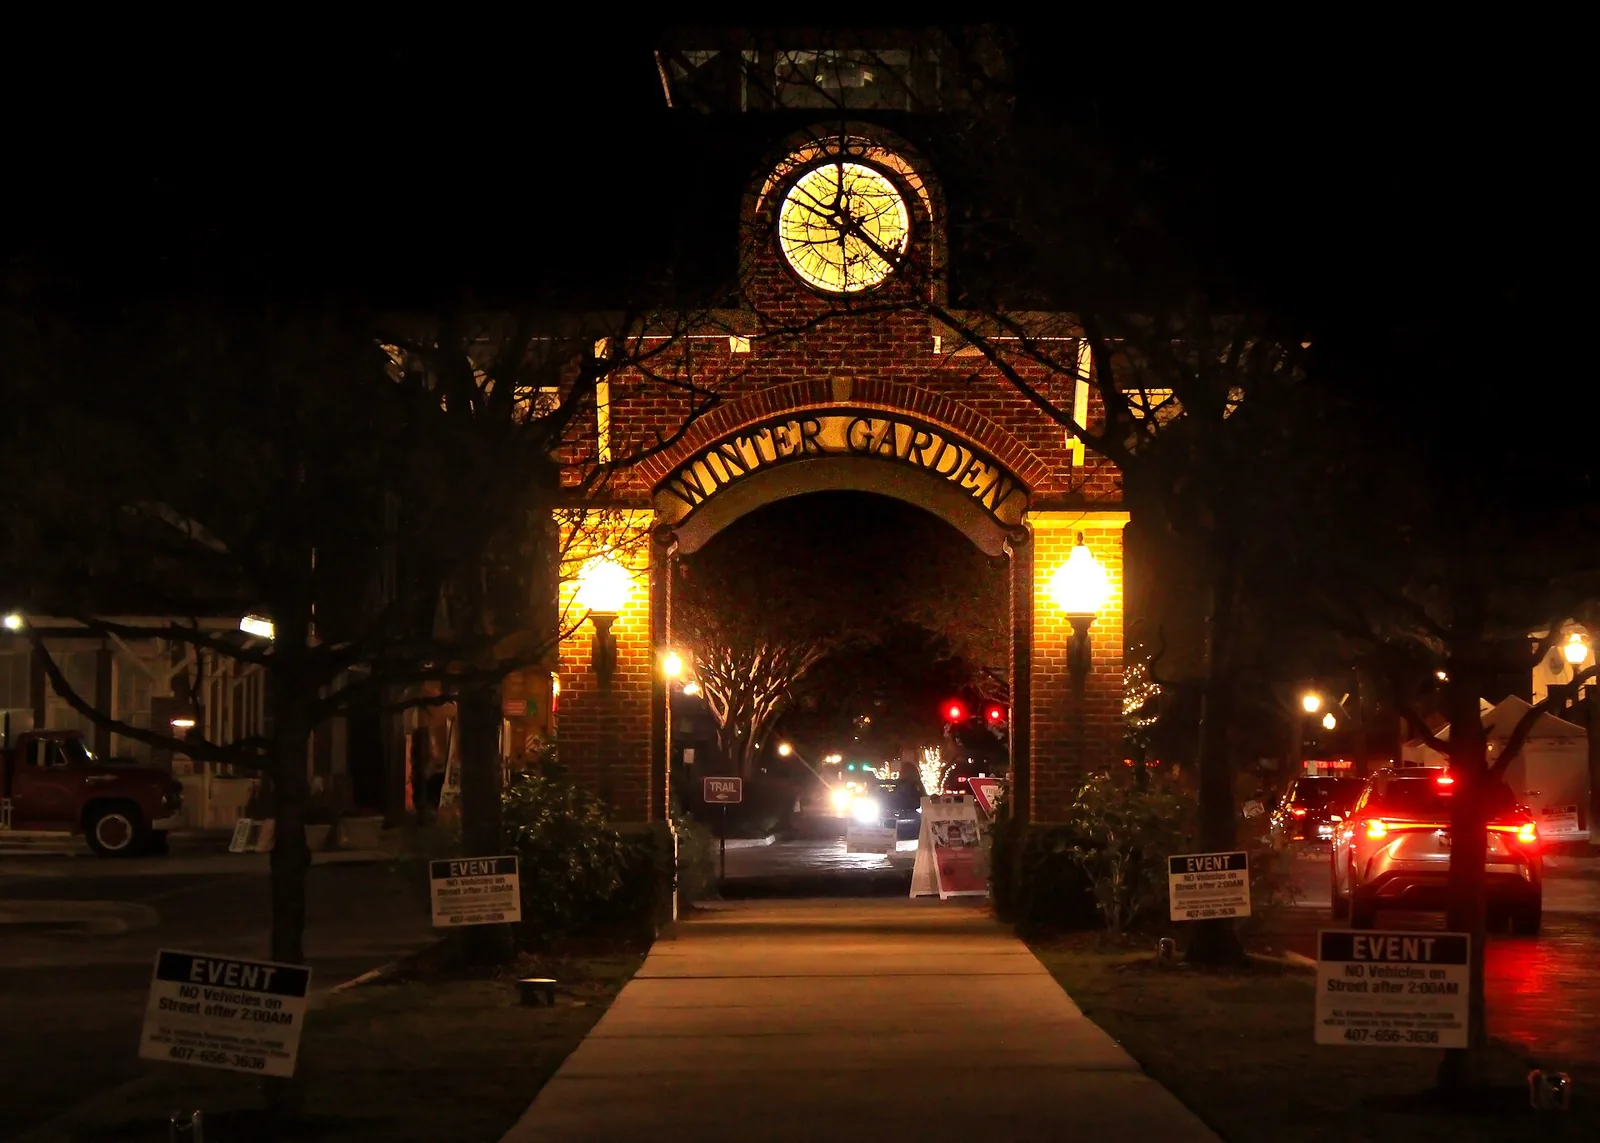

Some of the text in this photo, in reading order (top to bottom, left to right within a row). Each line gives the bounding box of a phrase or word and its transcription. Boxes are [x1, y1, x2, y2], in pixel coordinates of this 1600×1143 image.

[669, 416, 1014, 512] WINTER GARDEN
[710, 781, 737, 792] TRAIL
[449, 860, 497, 876] EVENT
[1187, 855, 1230, 872] EVENT
[1352, 935, 1437, 961] EVENT
[189, 958, 277, 990] EVENT
[1345, 965, 1446, 980] NO Vehicles on
[1327, 979, 1458, 995] Street after 2:00AM
[179, 985, 282, 1010] NO Vehicles on
[159, 997, 293, 1025] Street after 2:00AM
[1344, 1029, 1439, 1044] 407-656-3636
[168, 1046, 265, 1069] 407-656-3636
